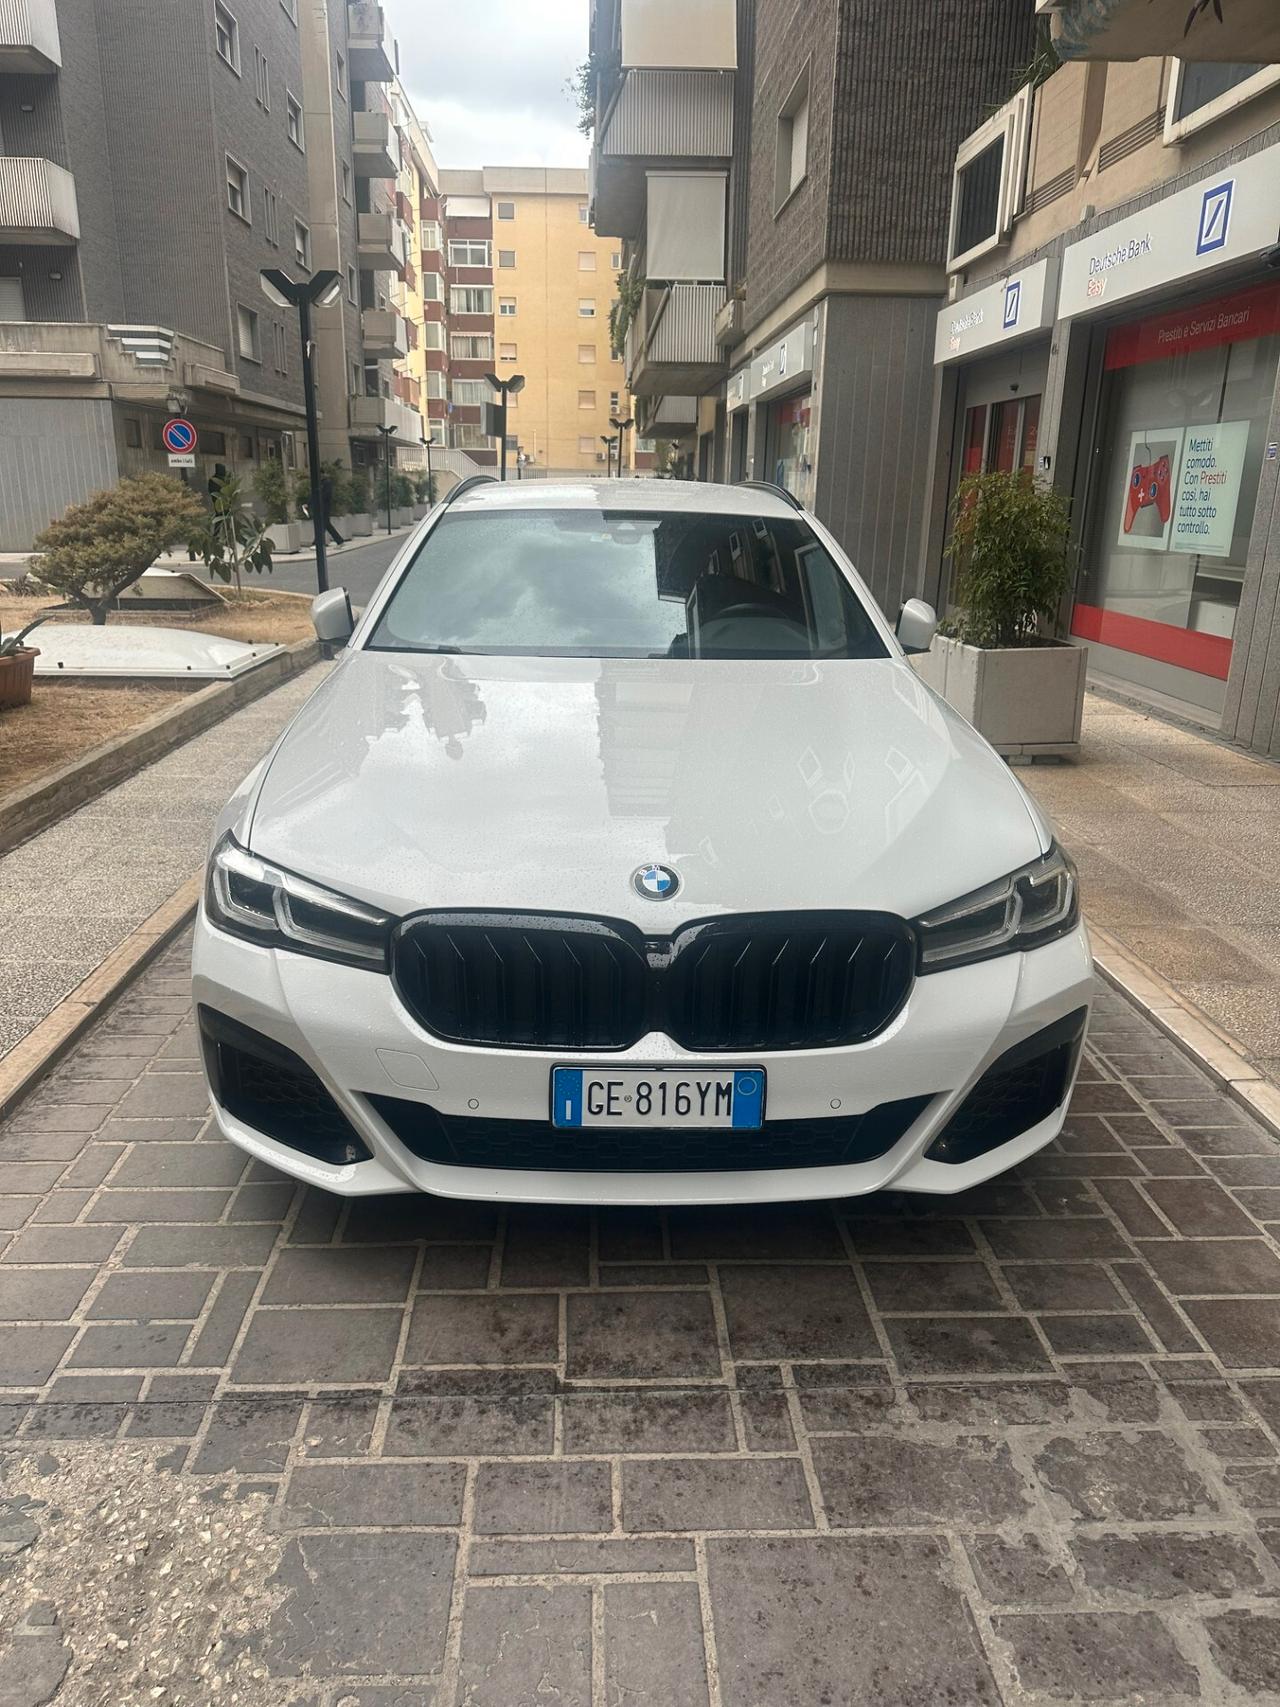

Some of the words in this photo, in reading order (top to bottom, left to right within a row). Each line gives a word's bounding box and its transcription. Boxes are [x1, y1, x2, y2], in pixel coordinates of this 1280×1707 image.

[1089, 246, 1127, 275] Deutsche
[1128, 232, 1151, 260] Bank
[1087, 278, 1107, 296] Easy
[1189, 316, 1216, 336] Servizi
[1217, 306, 1250, 329] Bancari
[1189, 438, 1214, 452] Mettiti
[1186, 455, 1217, 469] comodo.
[1184, 471, 1199, 485] Con
[1200, 470, 1228, 485] Prestiti
[1199, 488, 1212, 501] hai
[1179, 505, 1197, 517] tutto
[1198, 505, 1217, 518] sotto
[1177, 521, 1210, 534] controllo.
